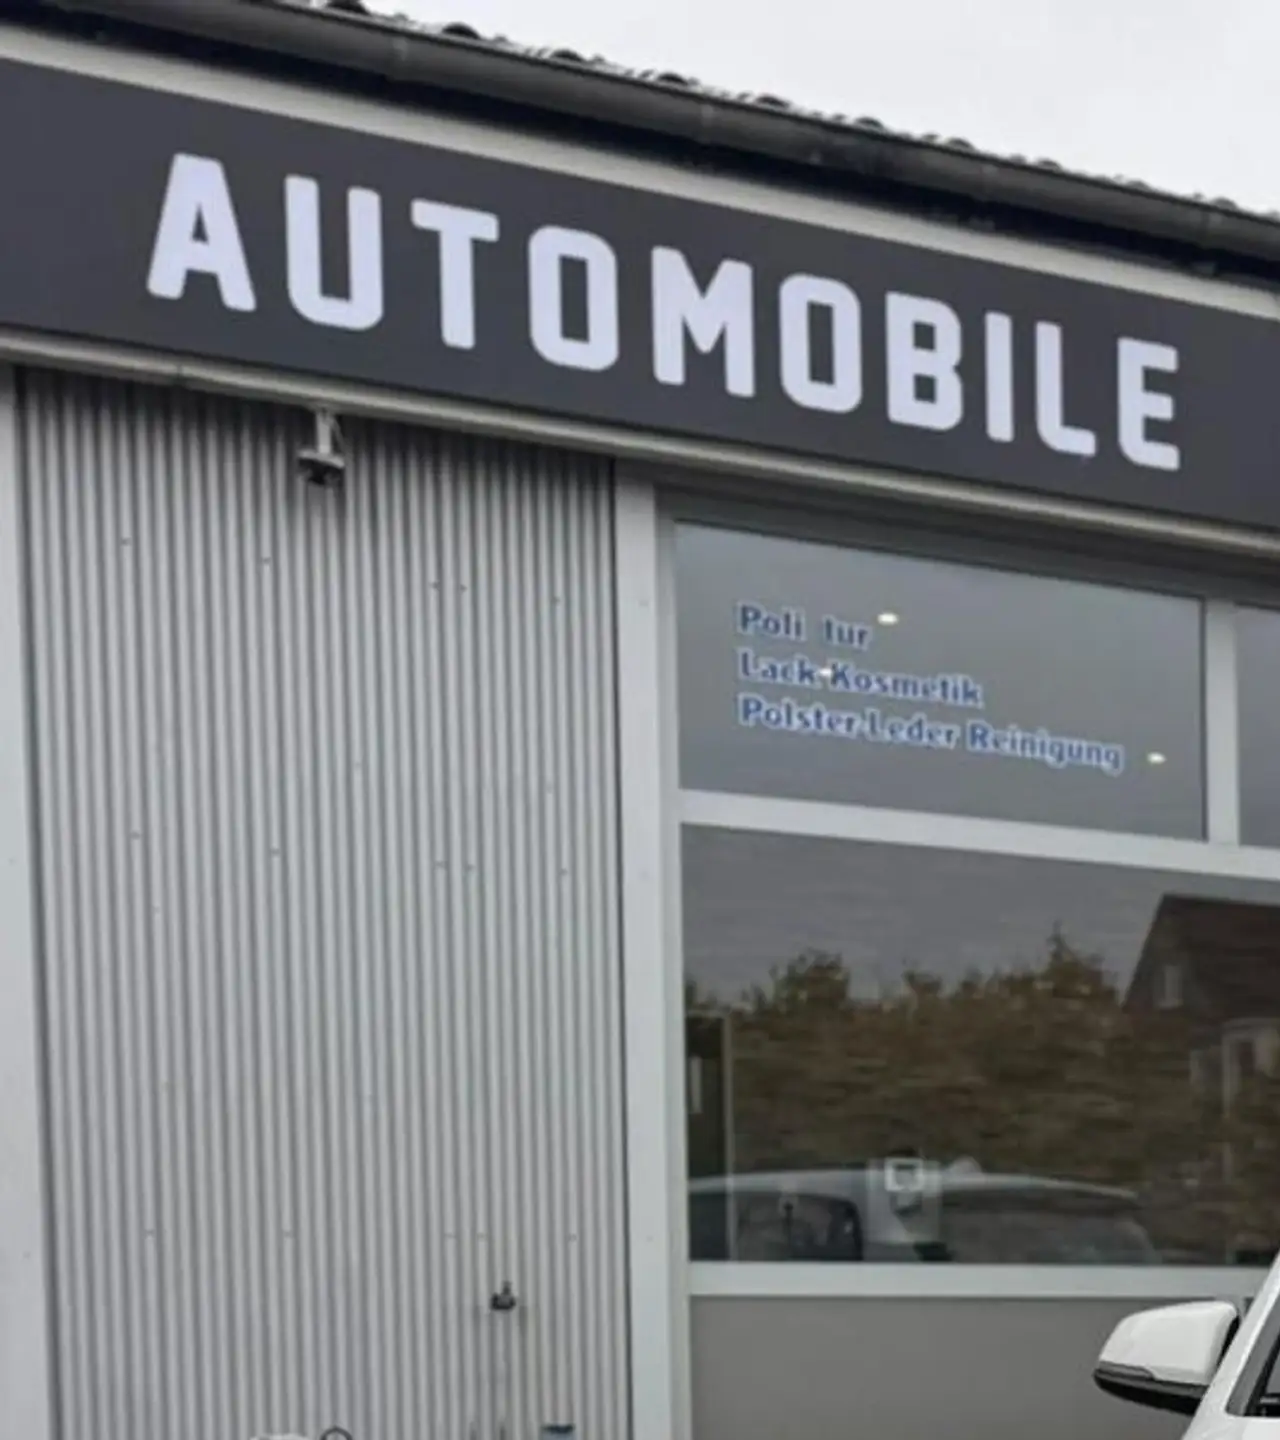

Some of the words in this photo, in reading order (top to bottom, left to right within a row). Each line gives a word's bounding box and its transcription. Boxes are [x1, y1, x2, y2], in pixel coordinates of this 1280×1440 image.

[147, 153, 1181, 471] AUTOMOBILE
[738, 604, 804, 641] Poli
[967, 719, 1124, 775] Reinigung
